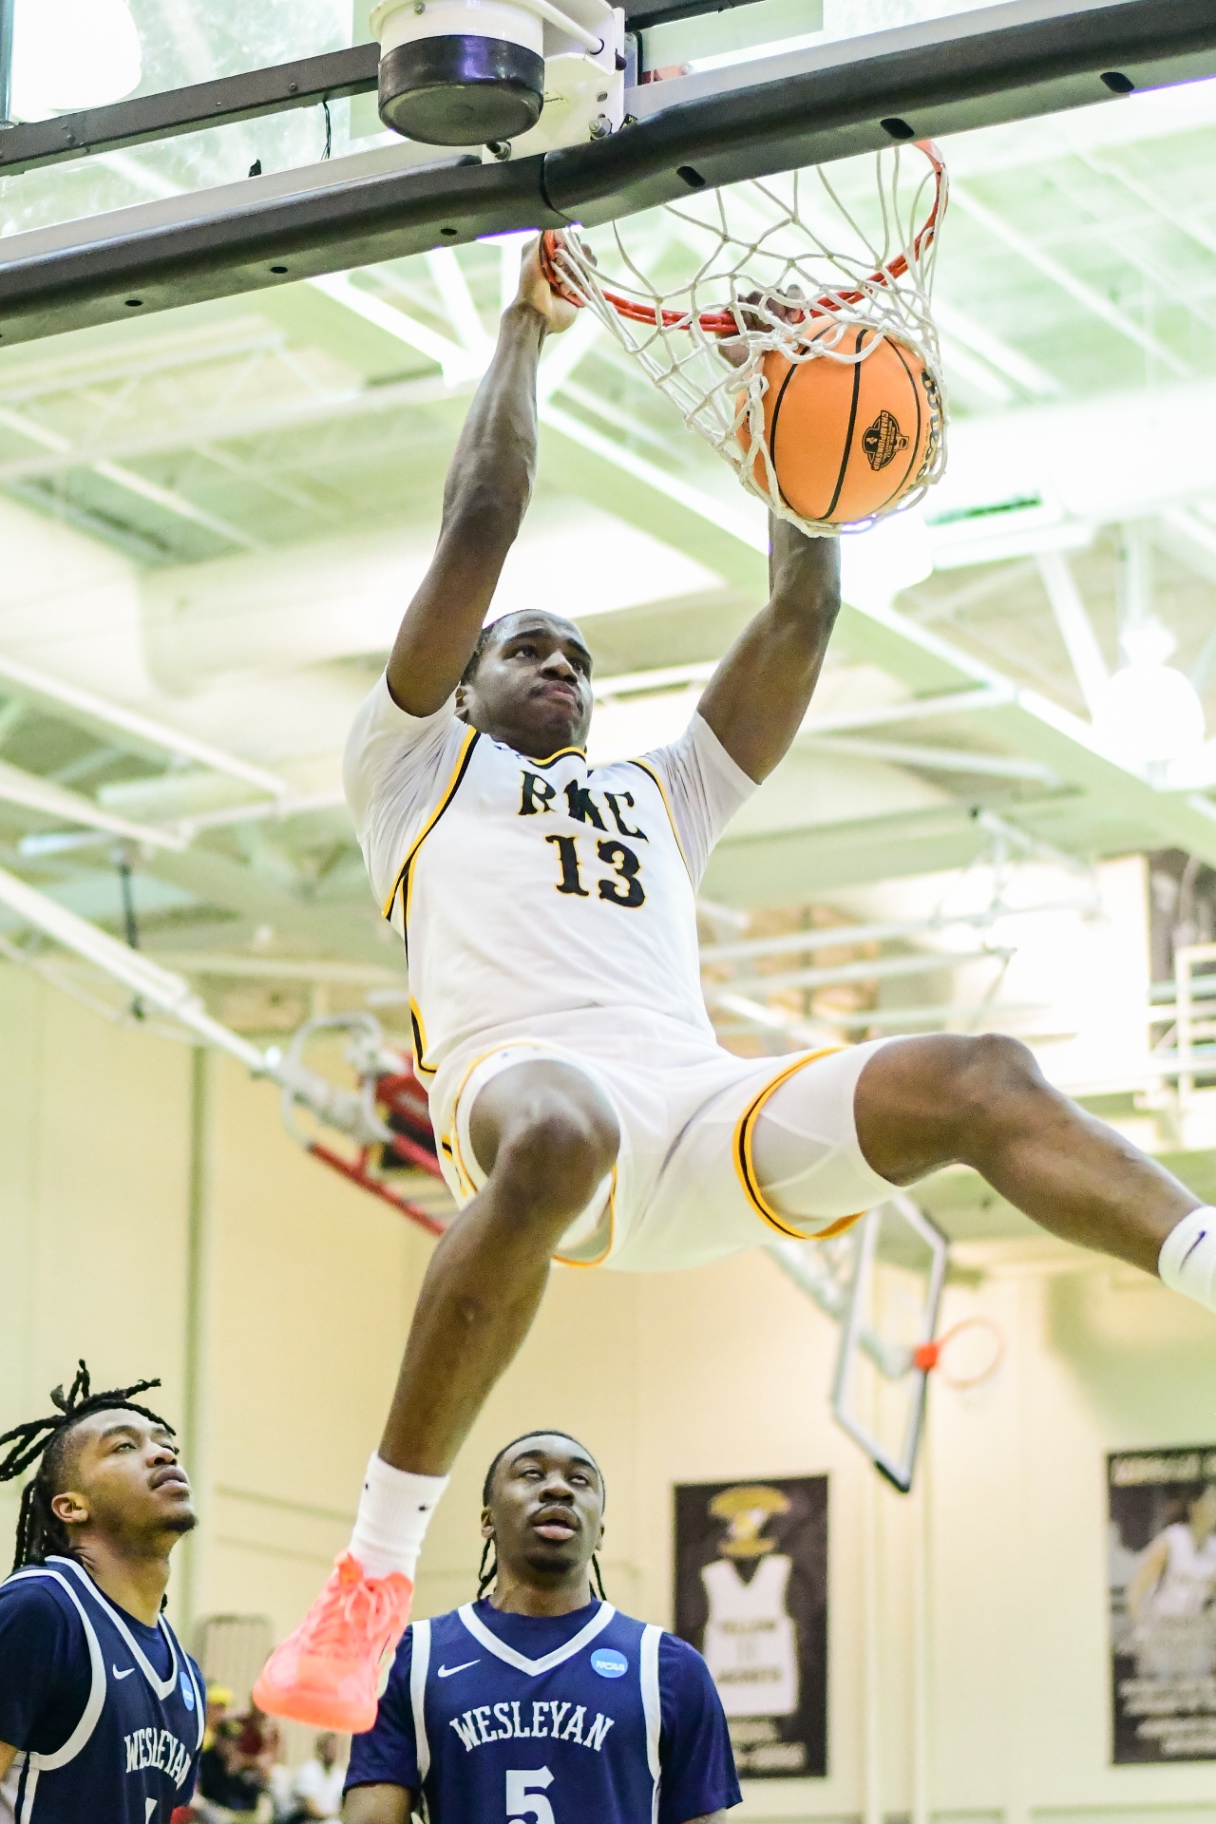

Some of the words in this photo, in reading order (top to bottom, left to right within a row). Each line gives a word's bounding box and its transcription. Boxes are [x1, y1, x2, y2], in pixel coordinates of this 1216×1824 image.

[873, 411, 889, 470] CHAMPIONSHIP
[545, 834, 646, 908] 13
[596, 1660, 625, 1672] NCAA
[449, 1700, 615, 1752] WESLEYAN
[124, 1727, 192, 1791] WESLEYAN
[505, 1765, 556, 1824] 5
